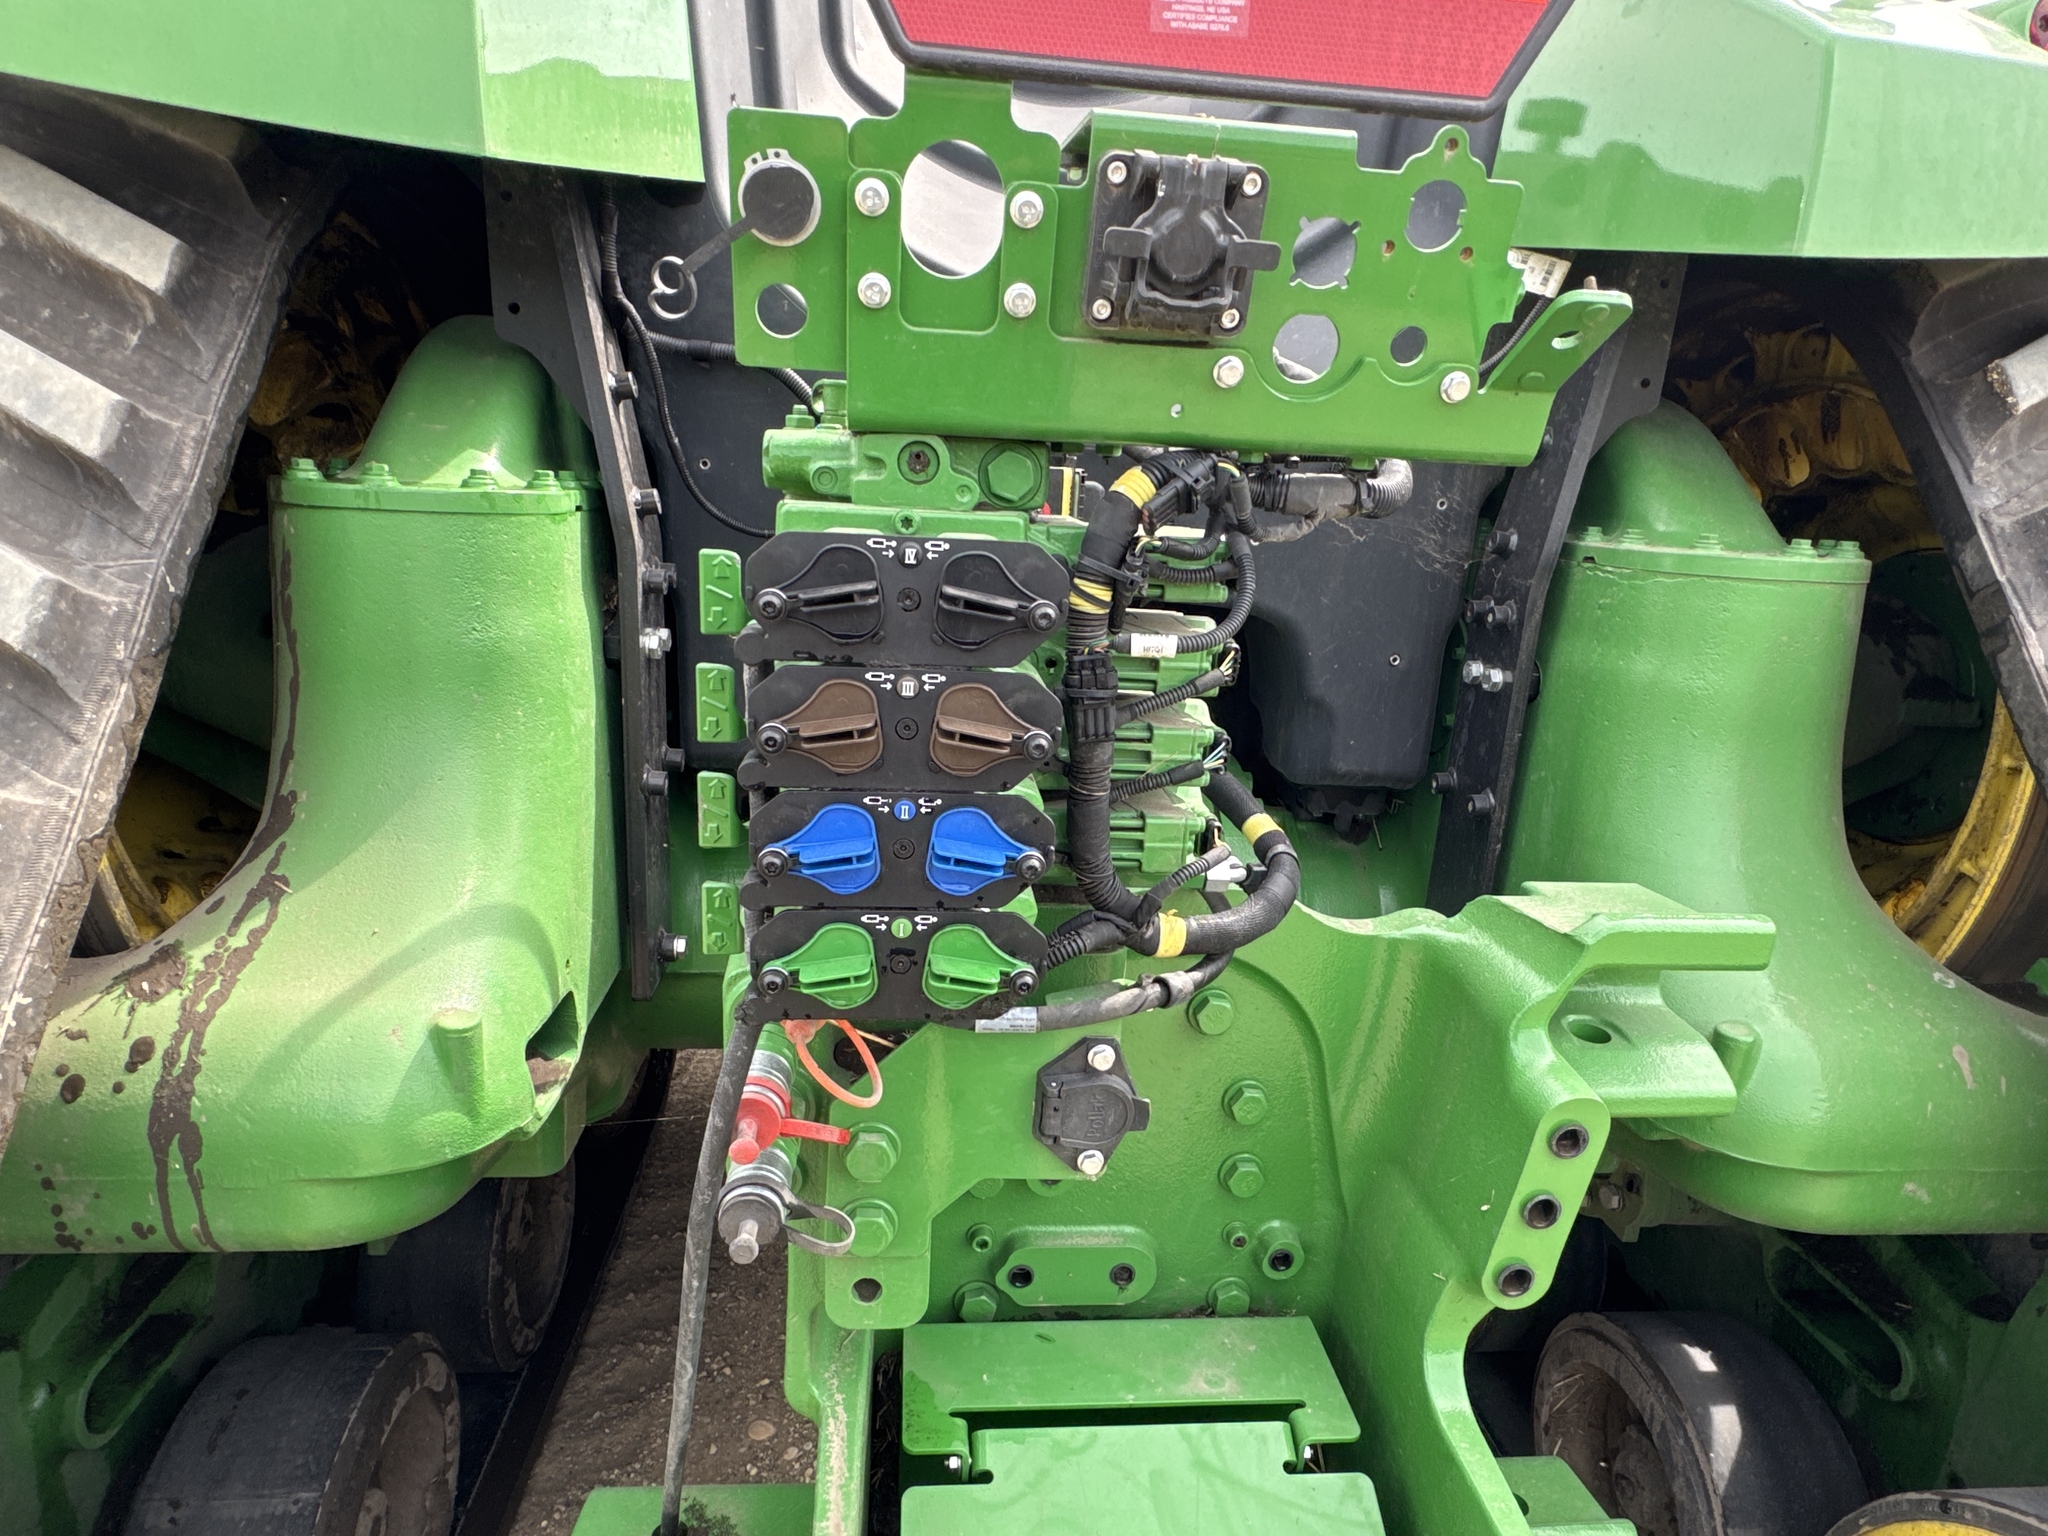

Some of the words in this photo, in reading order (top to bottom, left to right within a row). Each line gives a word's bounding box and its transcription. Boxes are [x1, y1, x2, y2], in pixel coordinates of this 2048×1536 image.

[1217, 6, 1231, 14] USA
[1197, 13, 1238, 23] COMPLIANCE
[904, 548, 917, 564] IV
[901, 681, 915, 696] III
[900, 805, 909, 819] II
[899, 923, 904, 937] I
[1086, 1093, 1107, 1137] Pollak
